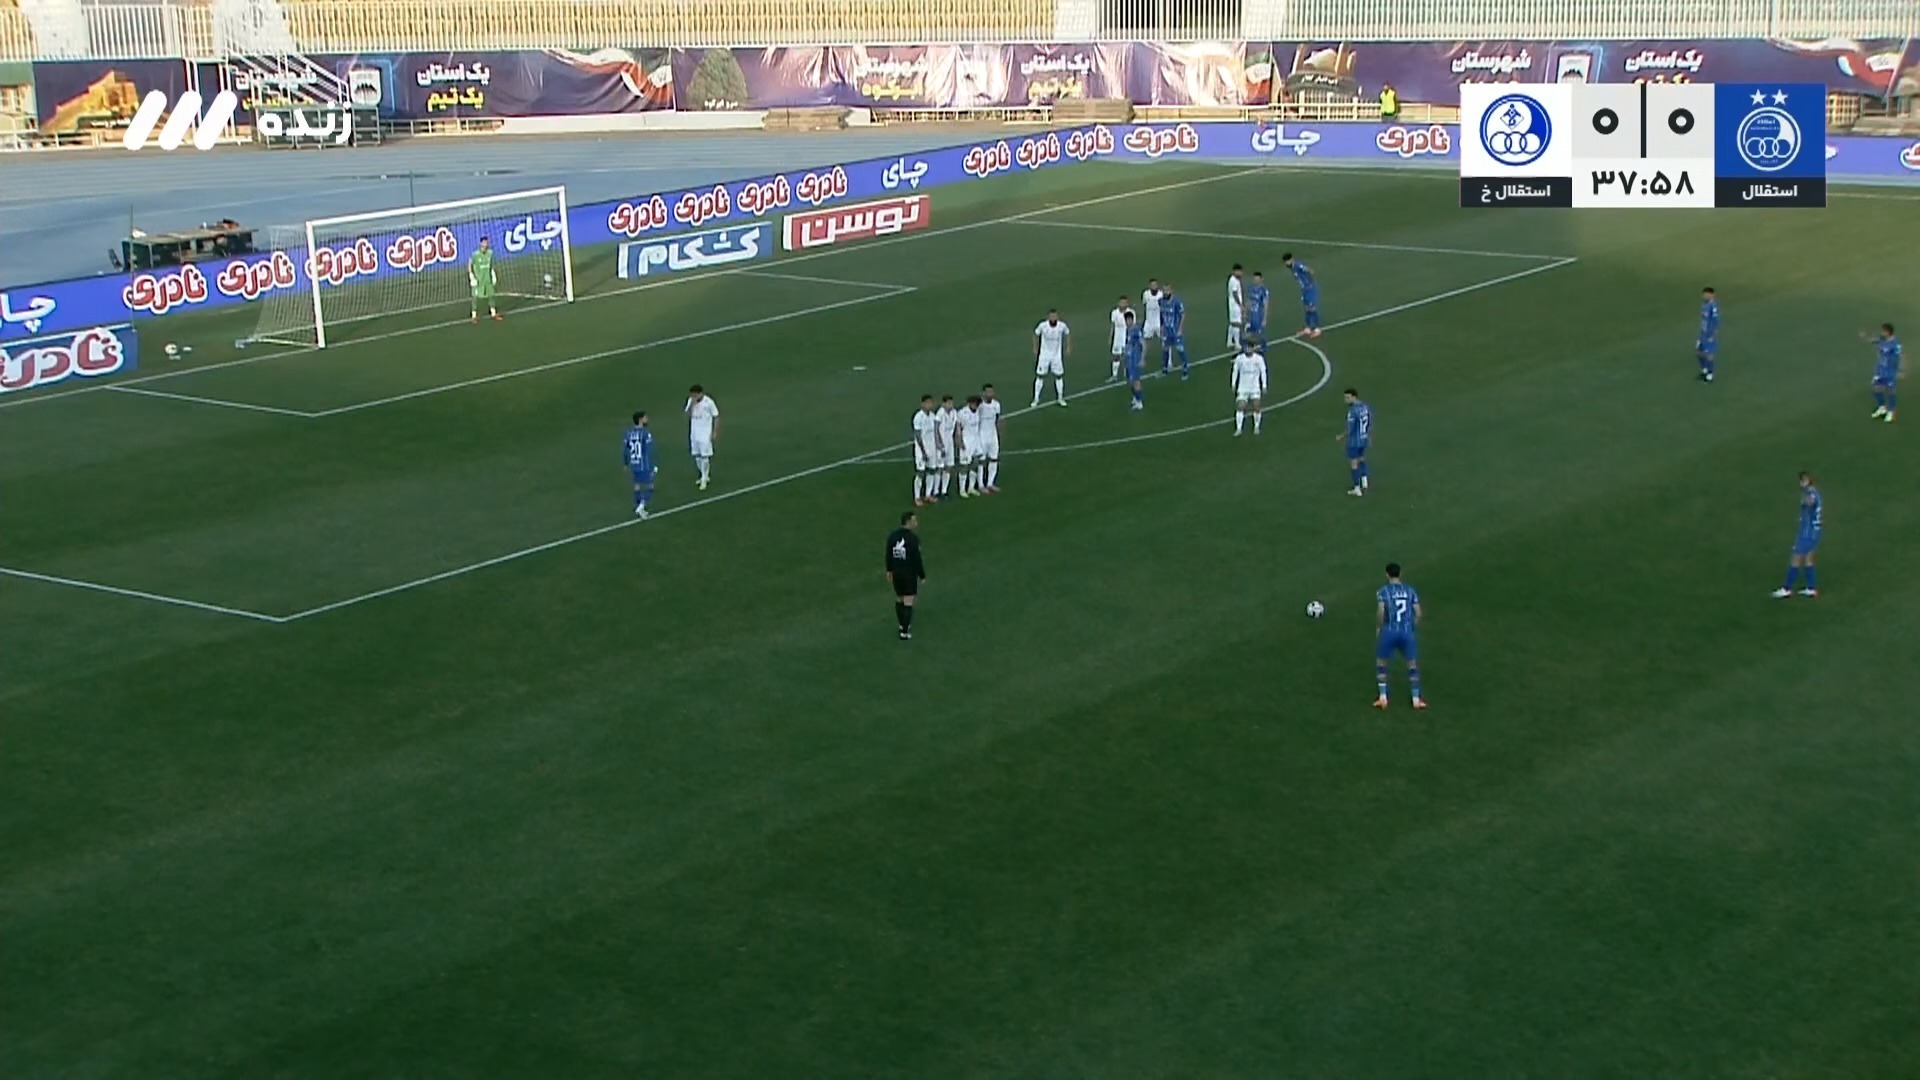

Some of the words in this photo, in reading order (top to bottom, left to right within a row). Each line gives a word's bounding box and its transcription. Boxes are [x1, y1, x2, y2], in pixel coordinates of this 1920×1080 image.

[417, 62, 465, 86] استان
[465, 62, 490, 85] یک
[1021, 53, 1066, 74] استان
[1452, 49, 1531, 74] شهرستان
[1625, 50, 1675, 71] استان
[1676, 50, 1703, 69] یک
[427, 87, 459, 112] تیم
[460, 86, 484, 109] یک
[1016, 132, 1060, 169] نادری
[1066, 124, 1114, 161] نادری
[1124, 123, 1198, 156] نادری
[1251, 124, 1320, 156] چای
[1376, 124, 1450, 157] نادری
[882, 158, 928, 189] چای
[963, 140, 1011, 178] نادری
[738, 174, 790, 215] نادری
[796, 165, 847, 206] نادری
[608, 195, 667, 236] نادری
[674, 185, 730, 225] نادری
[801, 199, 919, 246] توسن
[387, 227, 457, 272] نادری
[505, 217, 562, 252] چای
[638, 227, 761, 277] کشکام
[218, 251, 296, 301] نادری
[306, 238, 377, 285] نادری
[123, 265, 207, 314] نادری
[0, 293, 56, 332] چا
[0, 327, 124, 391] نادر
[629, 441, 642, 459] 20
[1395, 599, 1406, 622] 7
